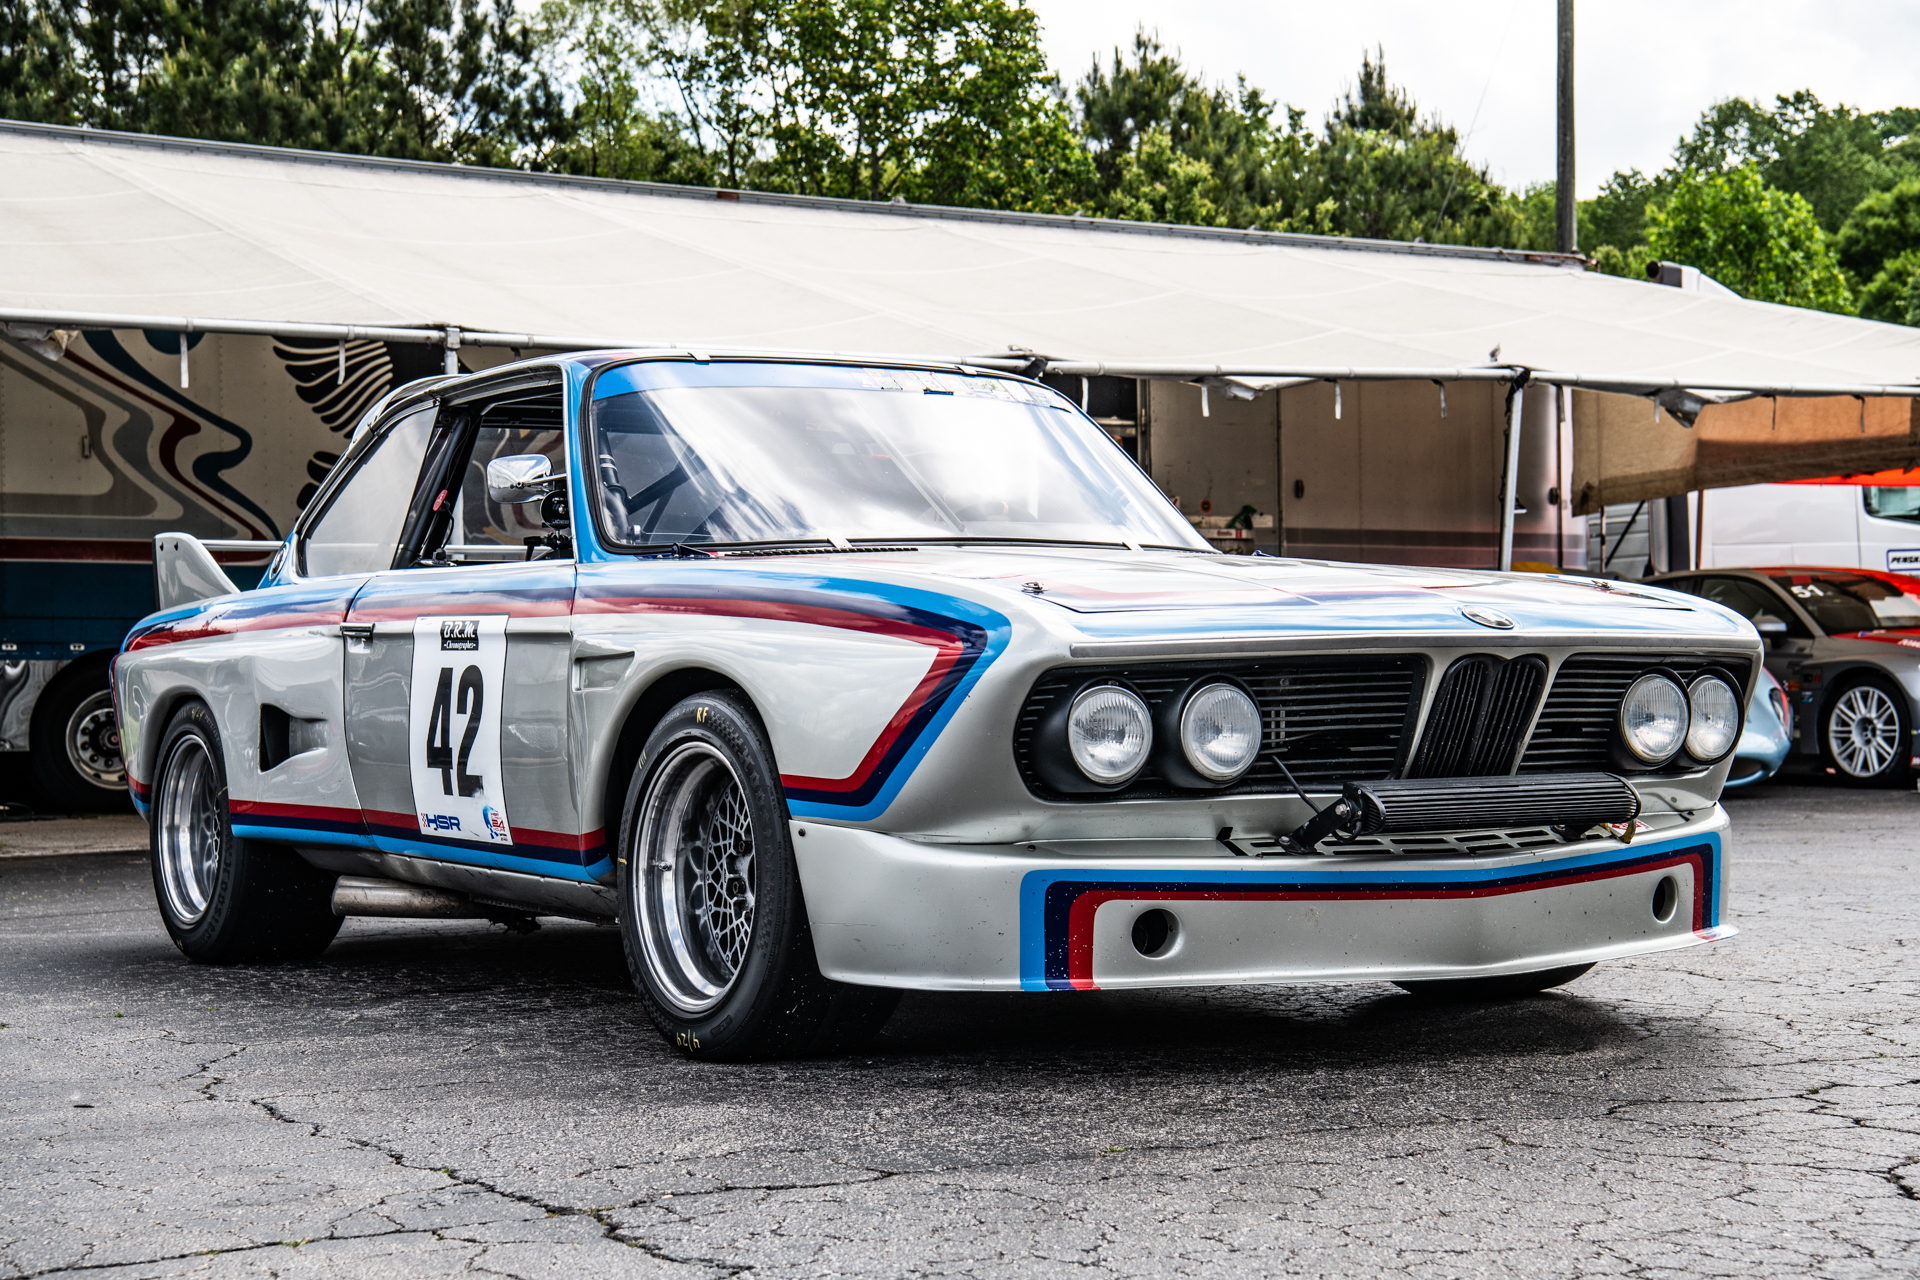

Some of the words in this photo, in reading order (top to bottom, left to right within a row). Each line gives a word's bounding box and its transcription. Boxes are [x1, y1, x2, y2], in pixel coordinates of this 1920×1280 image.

[1891, 556, 1920, 564] PENSK
[1790, 584, 1825, 598] 51
[696, 706, 709, 724] RF
[426, 664, 484, 798] 42
[425, 813, 462, 832] HSR
